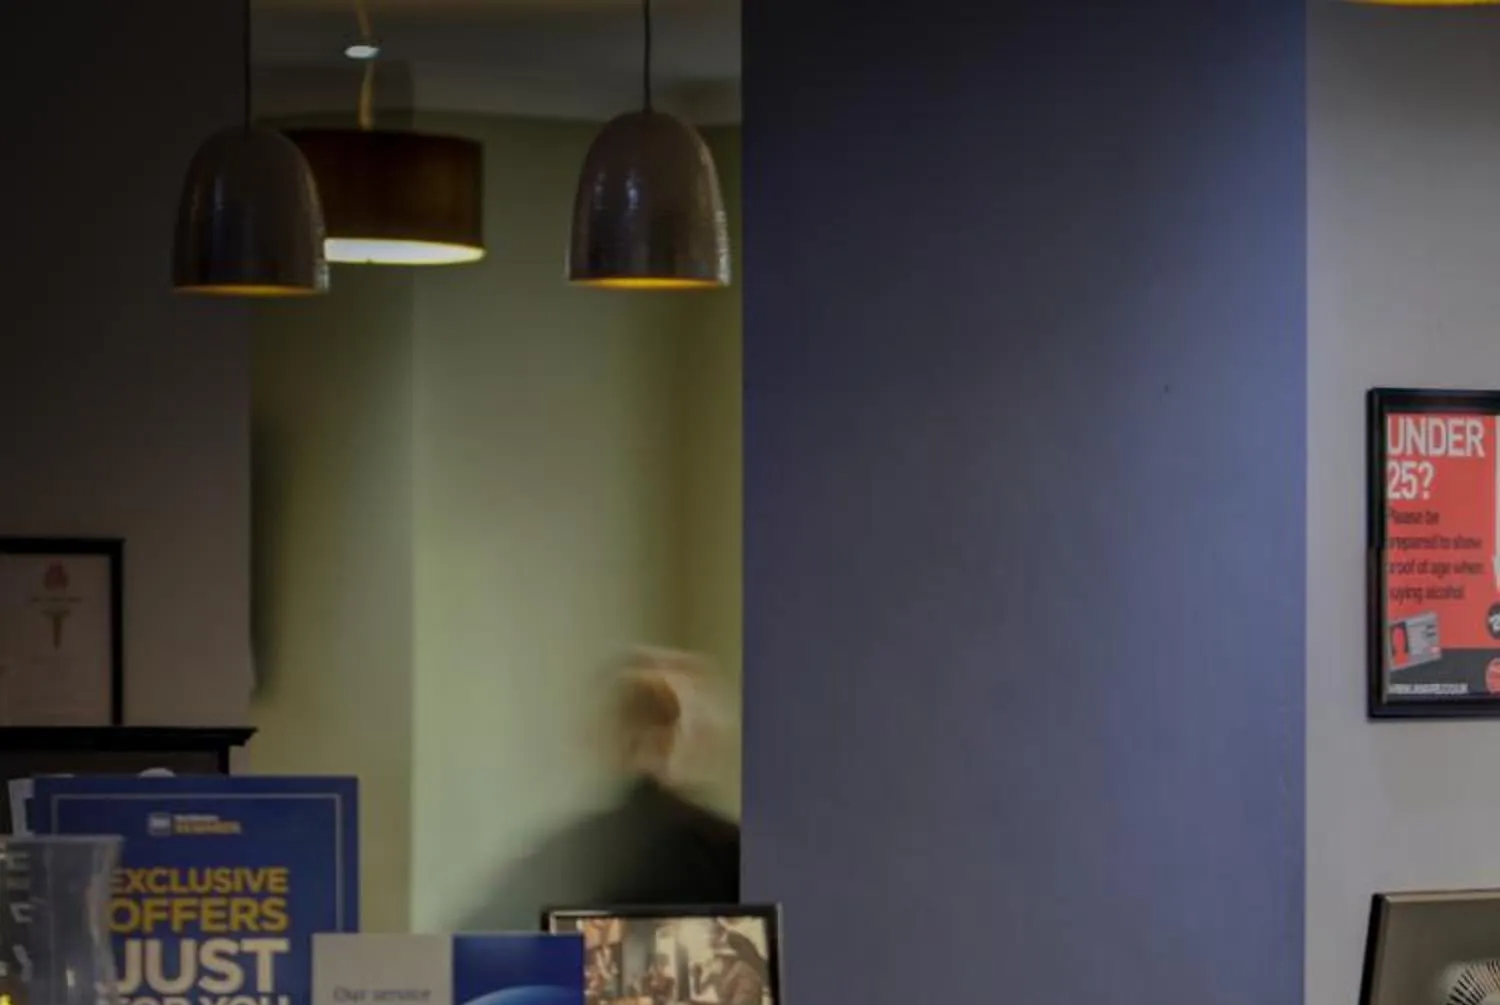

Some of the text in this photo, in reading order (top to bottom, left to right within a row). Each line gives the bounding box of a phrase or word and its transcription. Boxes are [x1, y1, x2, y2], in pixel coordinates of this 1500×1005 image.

[1387, 416, 1485, 458] UNDER
[1387, 460, 1435, 500] 25?
[110, 866, 290, 894] EXCLUSIVE
[108, 896, 290, 933] OFFERS
[117, 937, 291, 996] JUST
